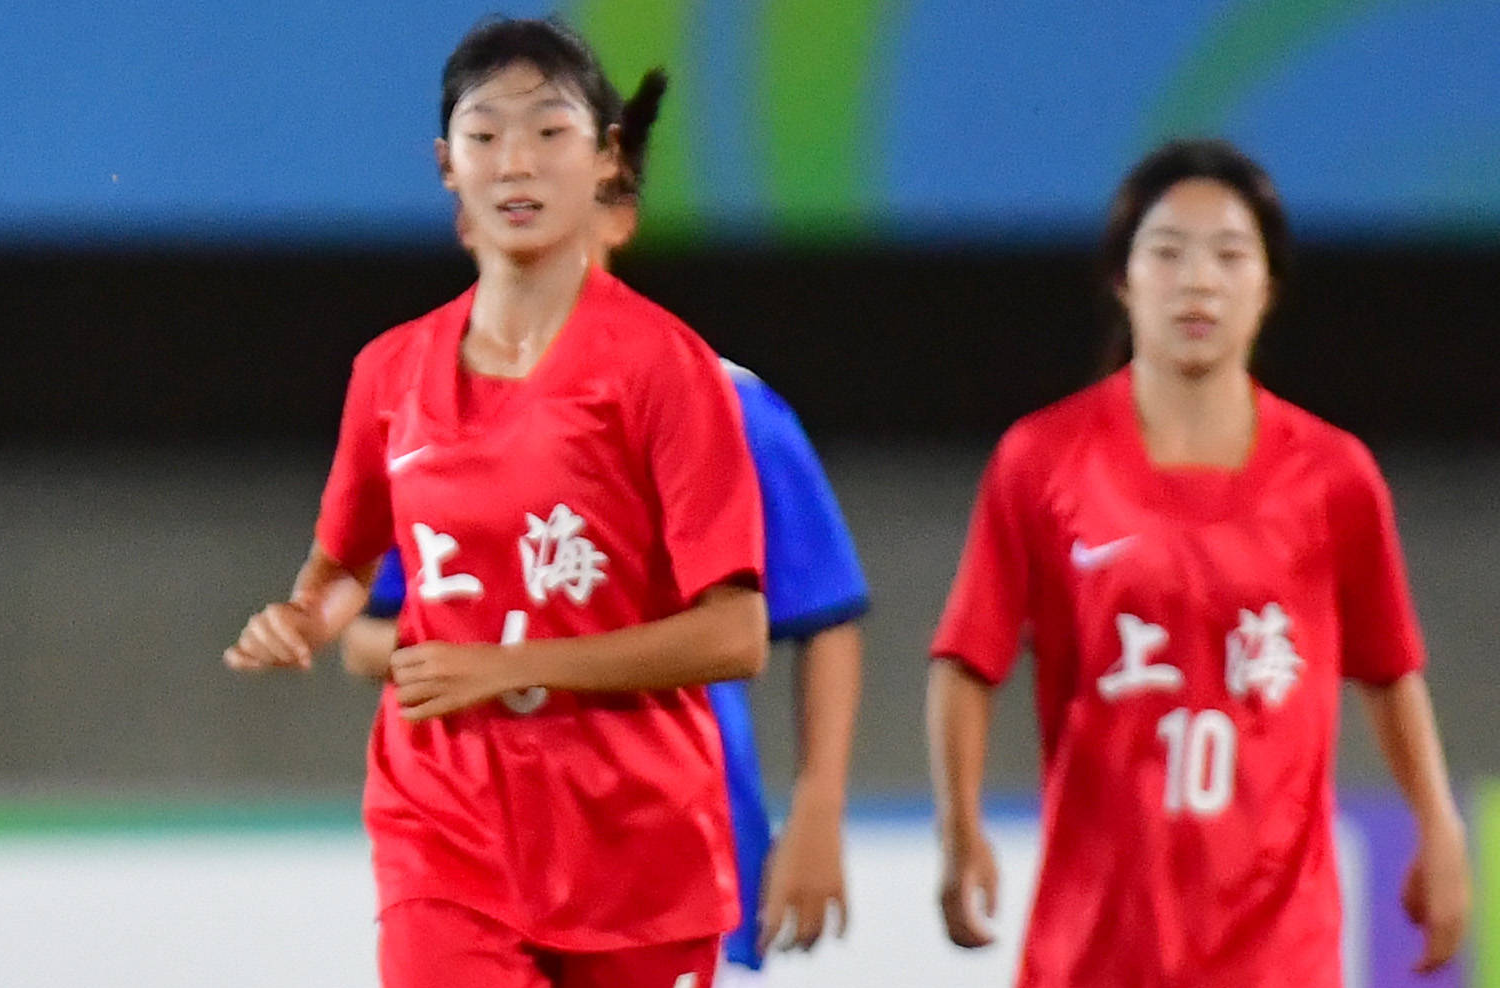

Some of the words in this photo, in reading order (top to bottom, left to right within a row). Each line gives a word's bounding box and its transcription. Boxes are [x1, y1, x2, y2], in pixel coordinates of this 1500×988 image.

[412, 503, 610, 605] 上海
[1097, 602, 1304, 706] 上海
[1157, 707, 1236, 816] 10
